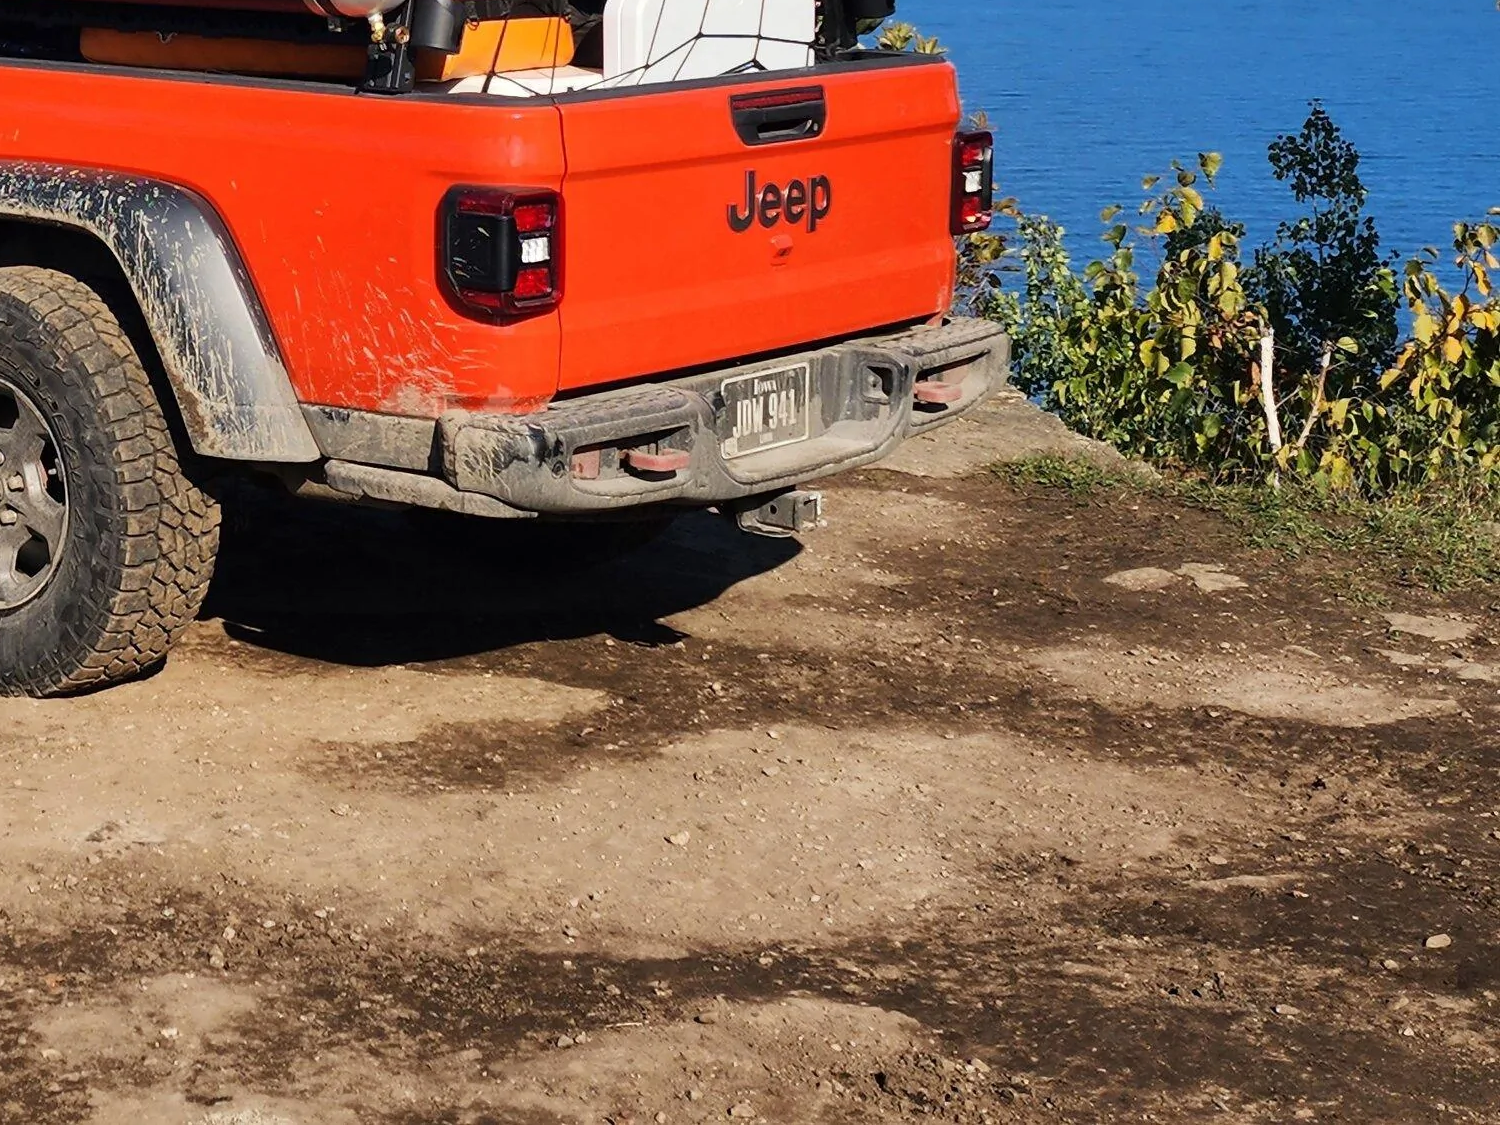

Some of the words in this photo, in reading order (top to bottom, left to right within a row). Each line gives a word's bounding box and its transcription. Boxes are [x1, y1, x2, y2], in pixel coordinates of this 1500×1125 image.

[727, 170, 831, 233] Jeep
[732, 395, 764, 439] JDW
[769, 388, 797, 429] 941
